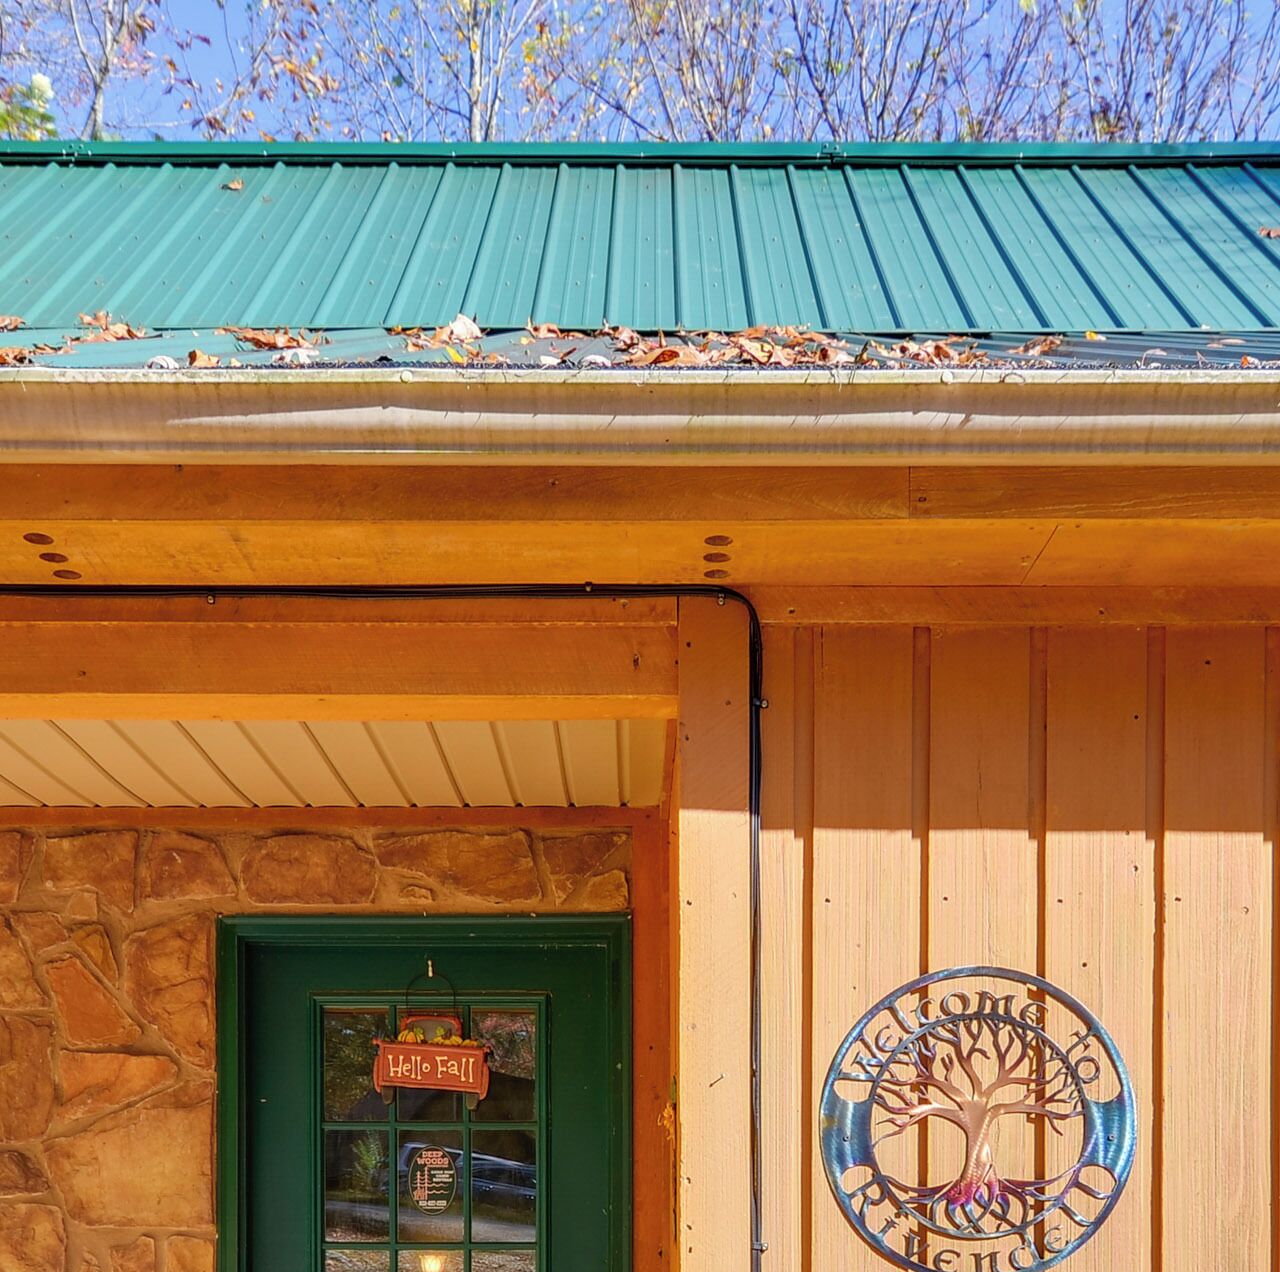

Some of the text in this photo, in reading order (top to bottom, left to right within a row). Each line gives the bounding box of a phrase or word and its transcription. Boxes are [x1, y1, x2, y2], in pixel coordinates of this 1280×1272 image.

[1067, 1029, 1100, 1084] to
[387, 1054, 475, 1083] Hello Fall
[416, 1157, 449, 1165] WOODS
[422, 1150, 444, 1158] DEEP
